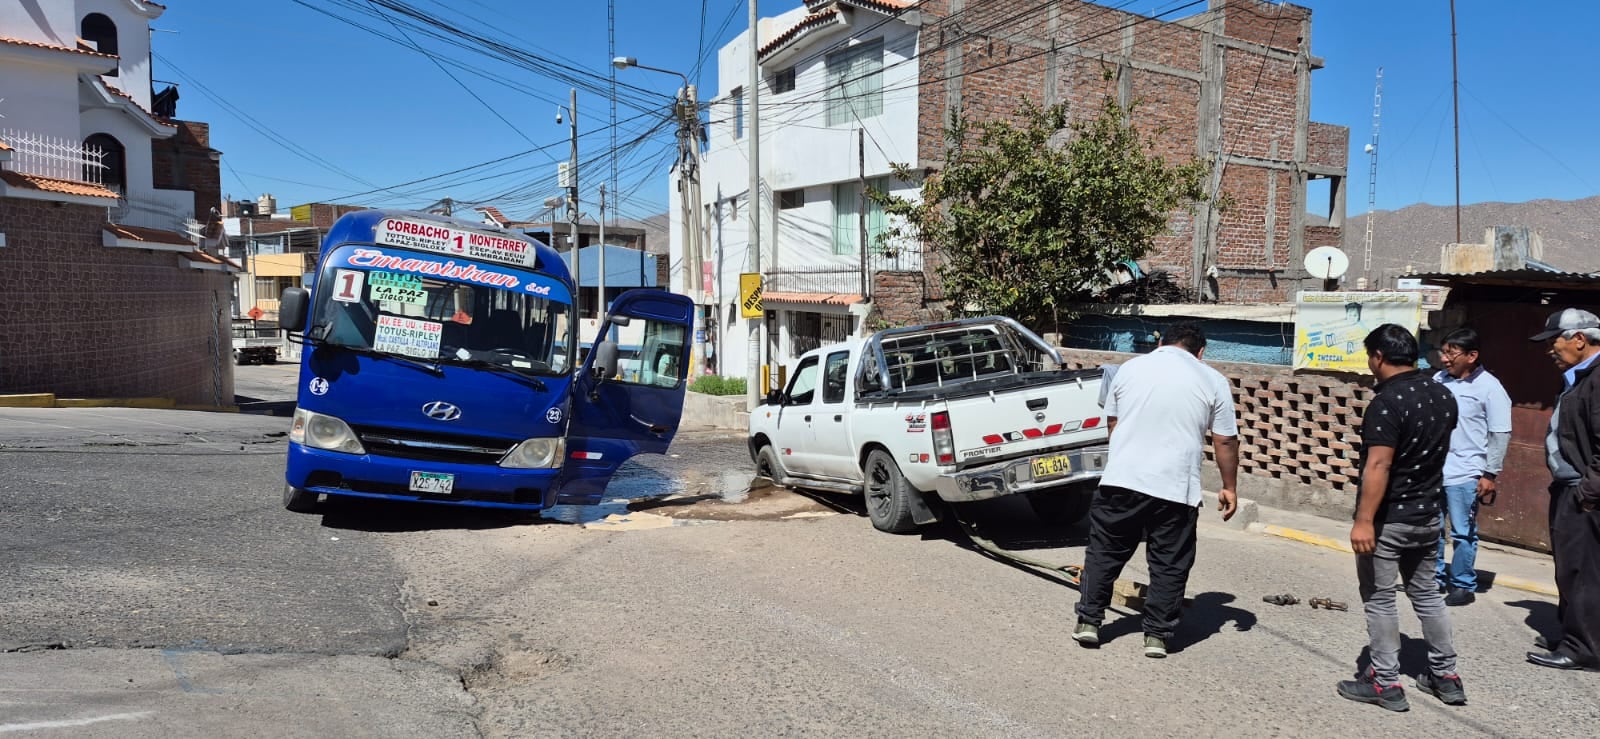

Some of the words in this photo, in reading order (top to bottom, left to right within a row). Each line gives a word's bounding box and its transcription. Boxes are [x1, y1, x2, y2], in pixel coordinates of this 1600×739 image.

[387, 219, 450, 240] CORBACHO
[453, 235, 463, 249] 1
[469, 233, 528, 253] MONTERREY
[469, 251, 524, 264] LAMBRAMANI
[348, 248, 520, 288] Emarsistran
[371, 272, 422, 283] TOTTUS
[339, 273, 355, 298] 1
[376, 286, 392, 294] LA
[398, 288, 425, 298] PAZ
[379, 293, 404, 302] SIGLO
[423, 322, 441, 332] ESEP
[375, 343, 385, 351] LA
[386, 344, 401, 353] PAZ
[405, 346, 426, 356] SIGLO
[549, 410, 560, 421] 23
[963, 446, 1002, 458] FRONTIER
